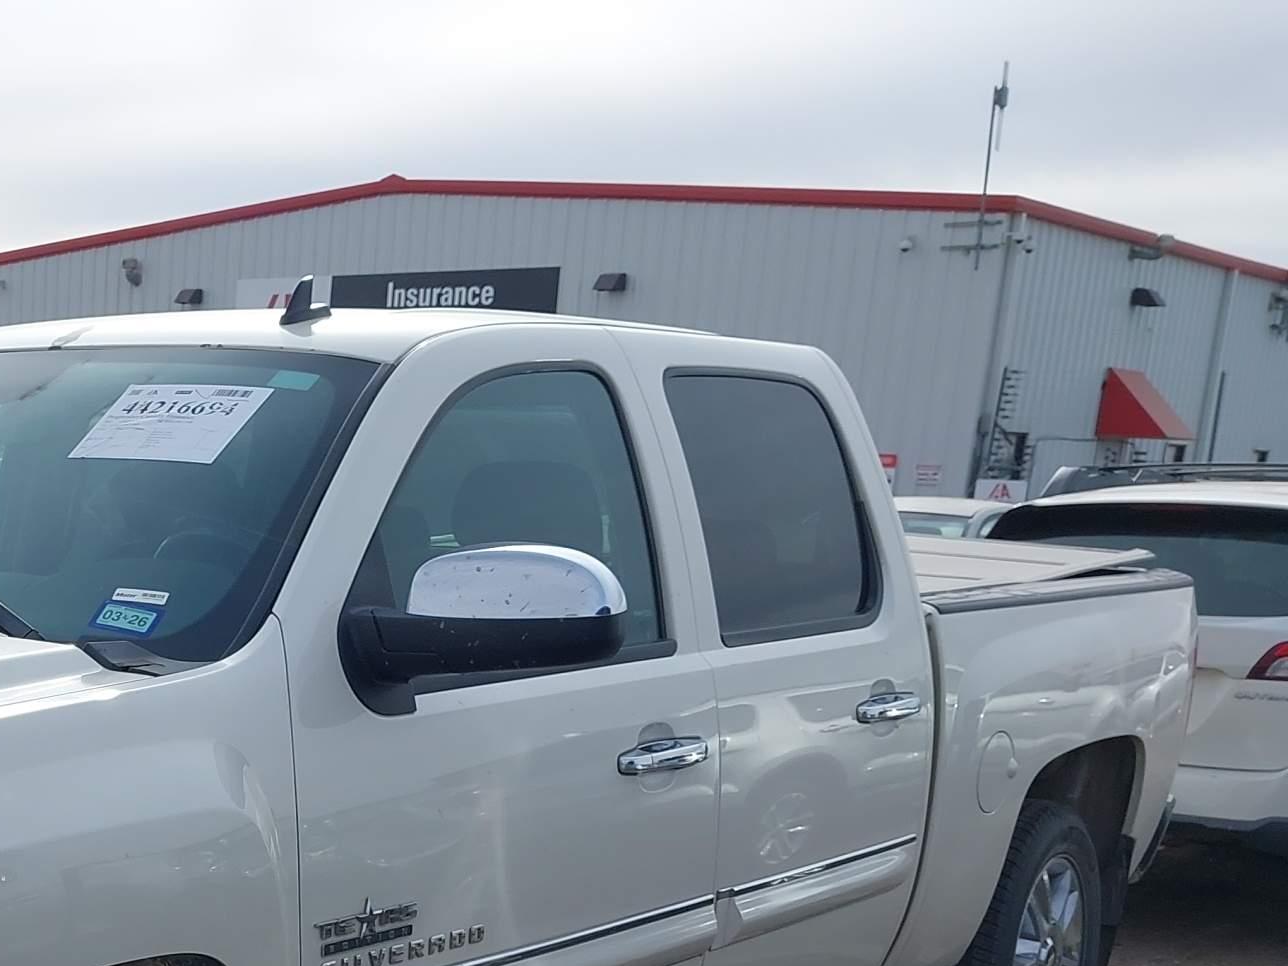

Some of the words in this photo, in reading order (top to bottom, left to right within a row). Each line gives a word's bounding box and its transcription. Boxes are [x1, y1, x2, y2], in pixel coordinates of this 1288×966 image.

[386, 281, 495, 307] Insurance
[121, 400, 239, 416] 44216694
[102, 609, 122, 622] 03
[128, 614, 149, 627] 26
